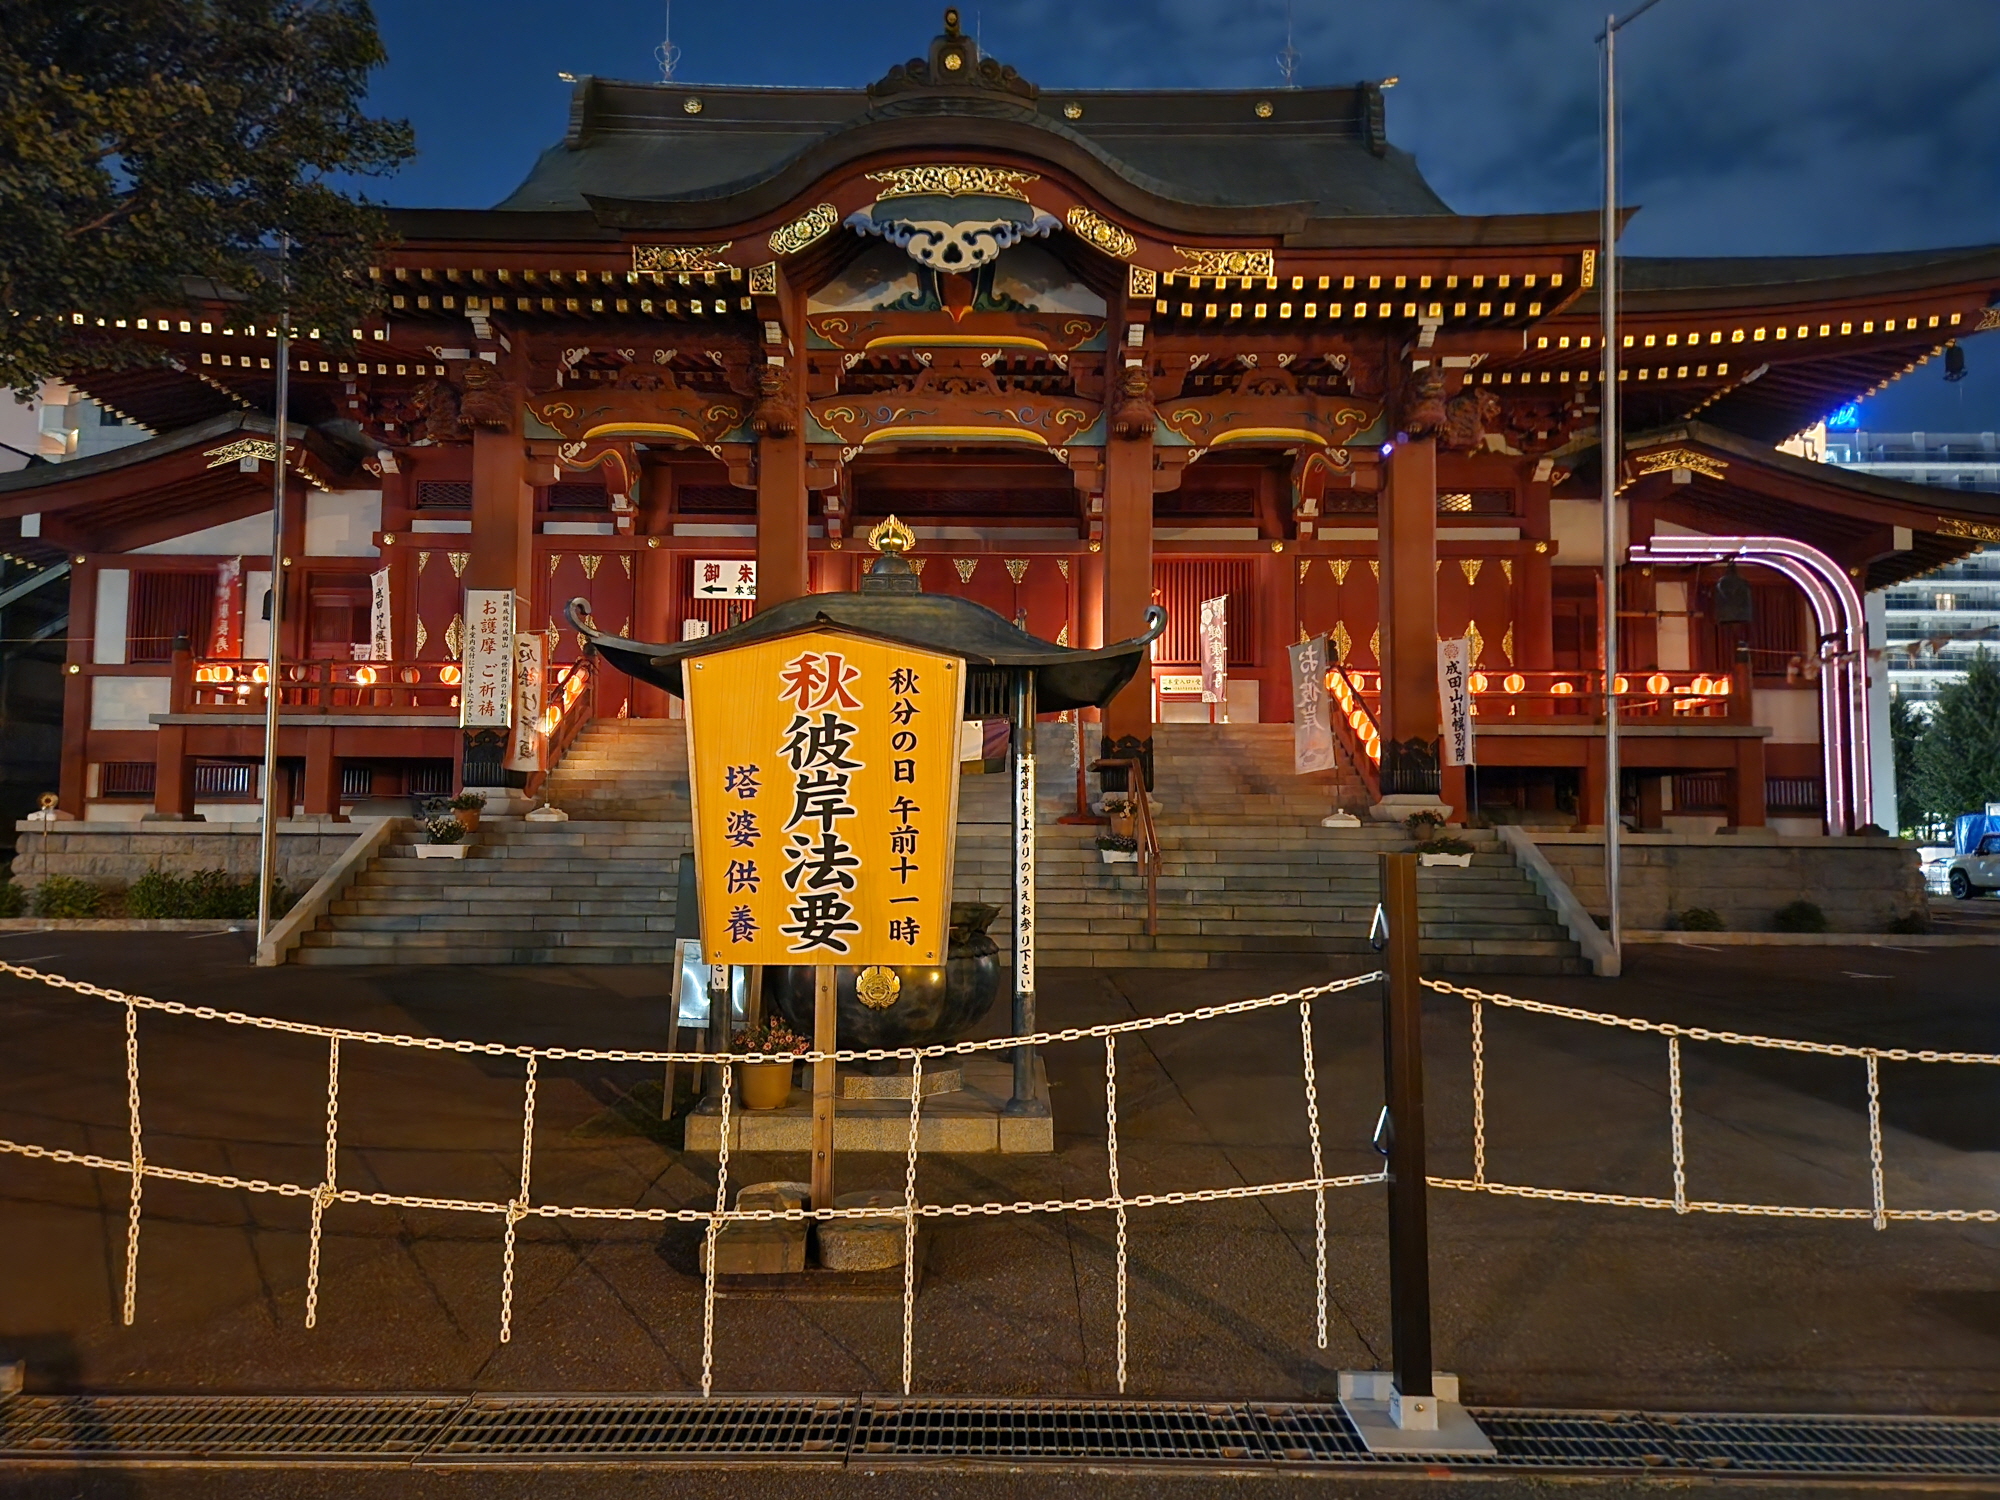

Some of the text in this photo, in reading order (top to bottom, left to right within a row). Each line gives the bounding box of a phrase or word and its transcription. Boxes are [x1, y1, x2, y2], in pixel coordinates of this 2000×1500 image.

[703, 563, 754, 583] 御朱
[734, 585, 756, 596] 本堂
[480, 599, 498, 655] お護摩
[1445, 660, 1466, 762] 成田山札幌別院
[723, 763, 762, 943] 塔婆供養
[777, 652, 864, 955] 秋彼岸法要
[1020, 763, 1032, 989] 本堂にお上がりのうえお参り下さい
